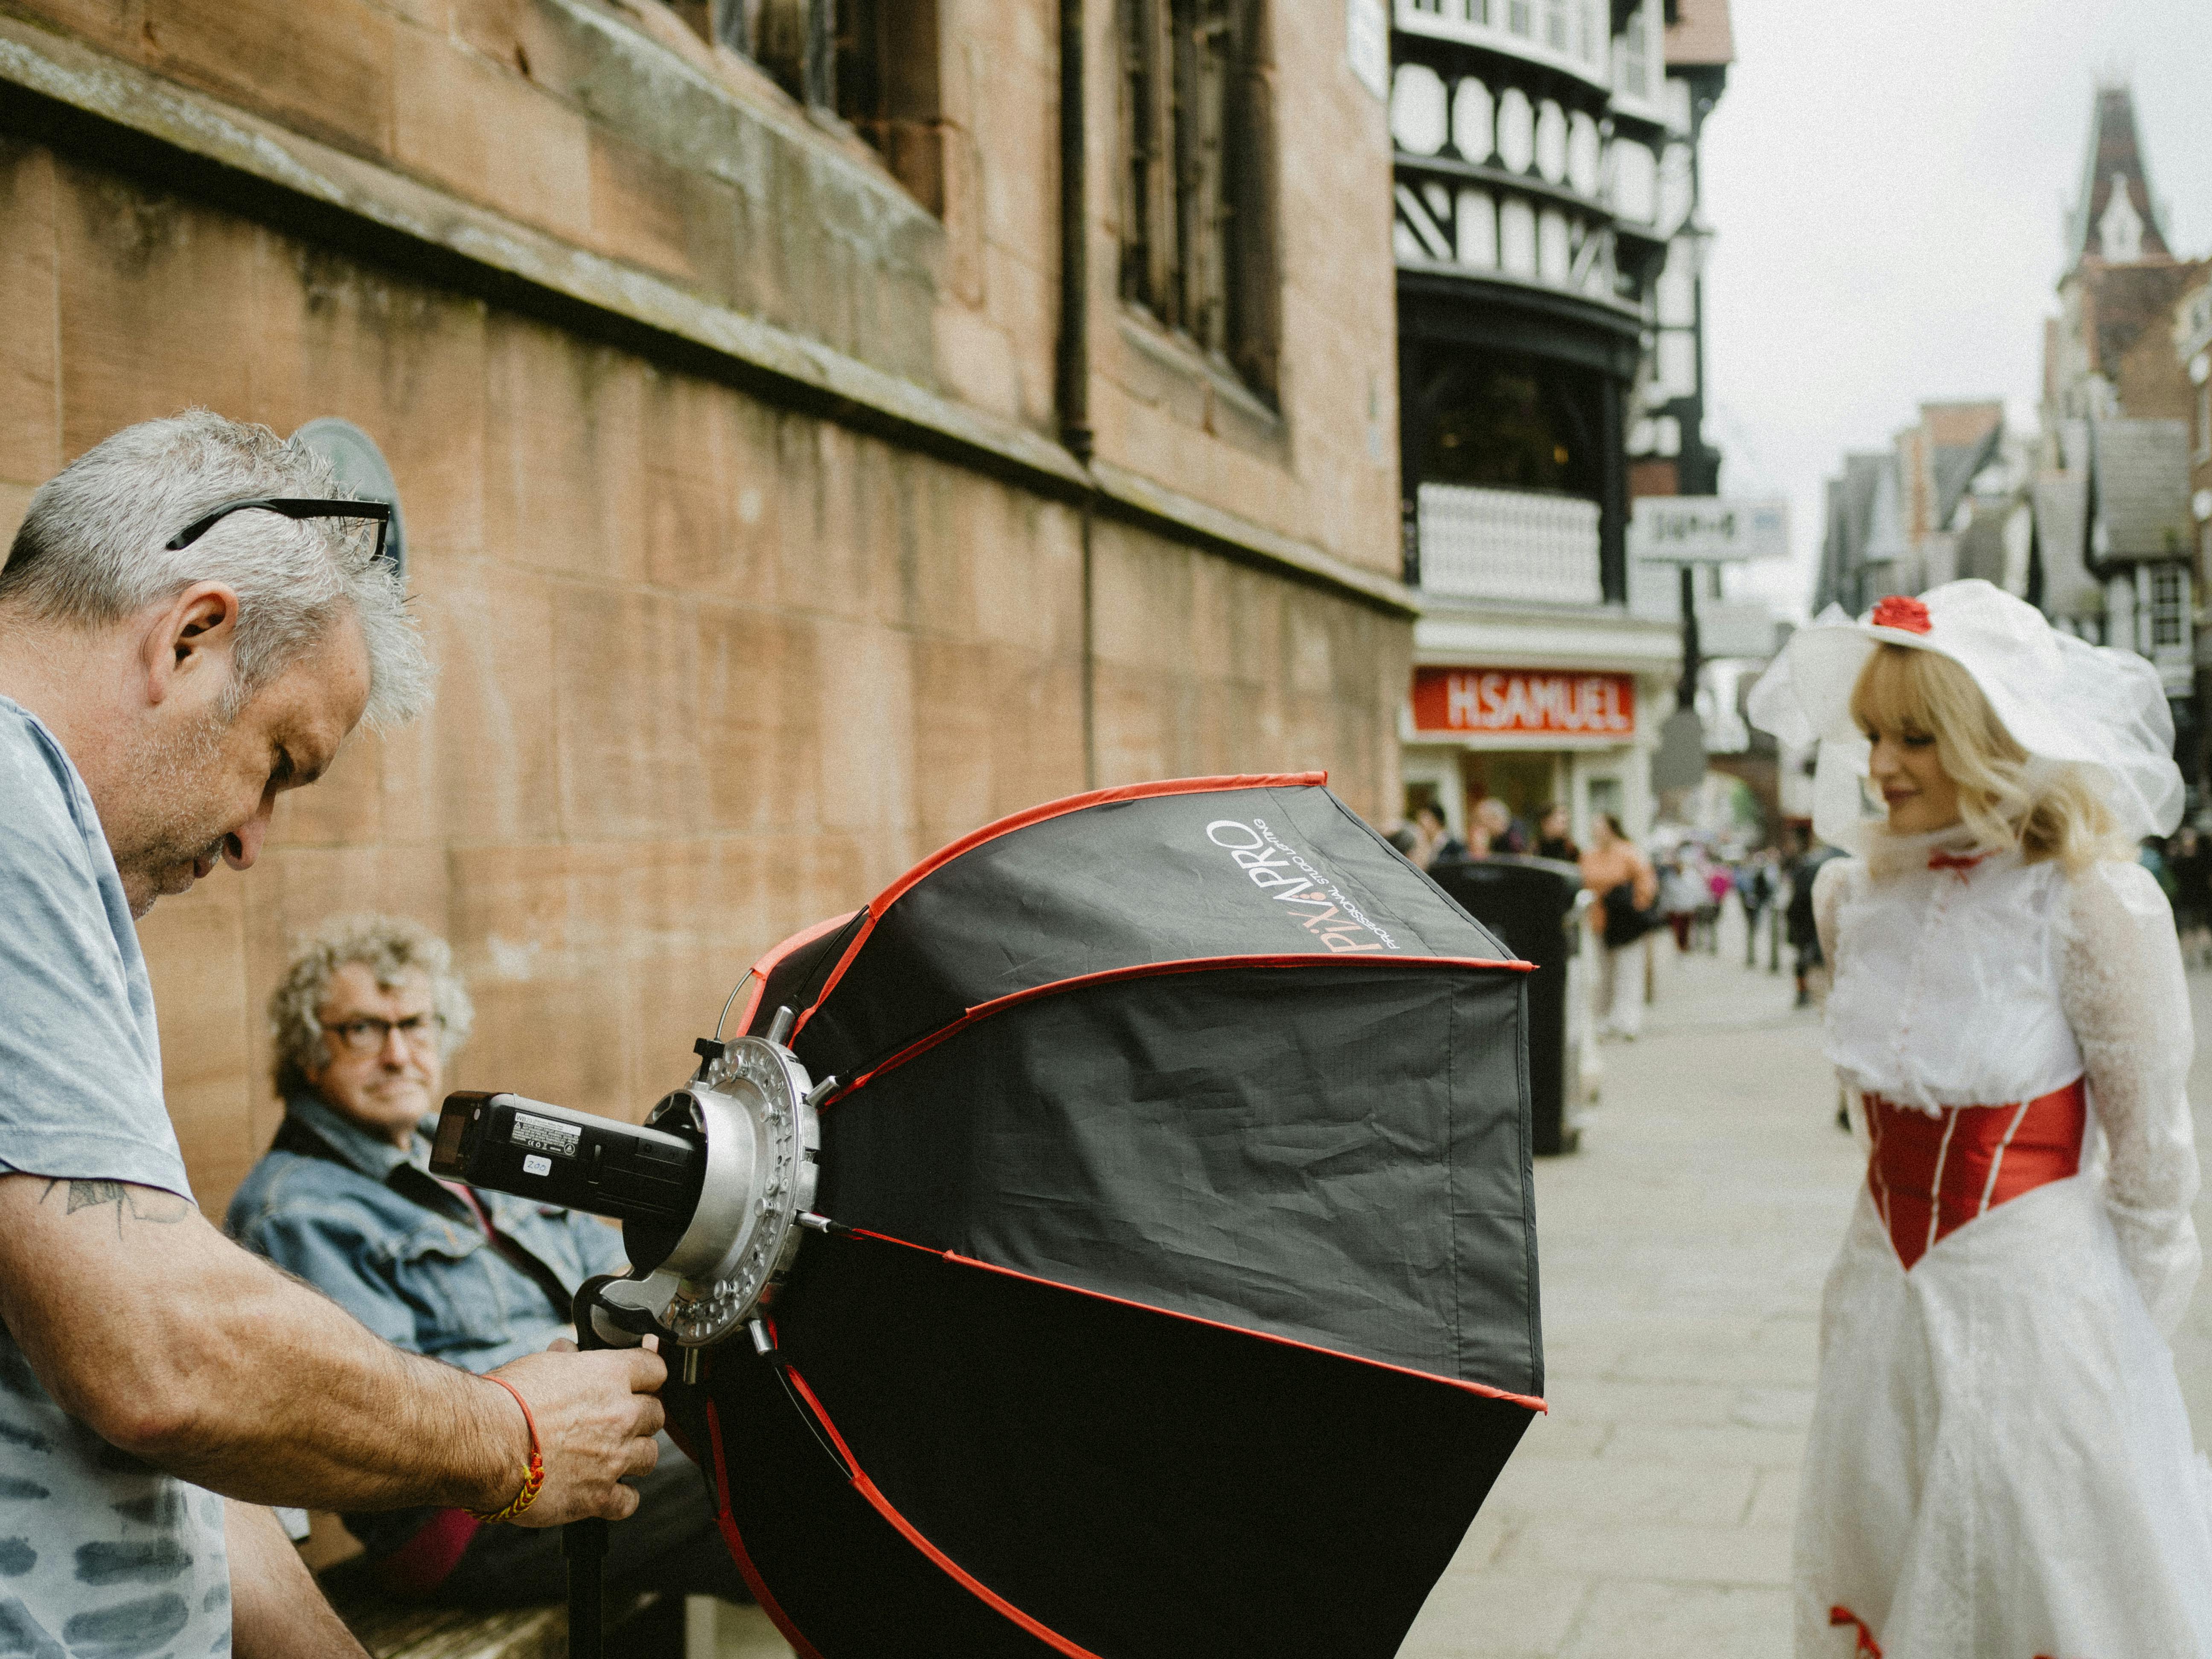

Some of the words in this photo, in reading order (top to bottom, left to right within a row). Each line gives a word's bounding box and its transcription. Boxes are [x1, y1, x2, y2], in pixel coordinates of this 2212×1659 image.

[1254, 818, 1296, 856] LIGHTING
[1292, 856, 1329, 885] STUDIO
[1328, 885, 1400, 950] PROFESSIONAL
[527, 1161, 546, 1171] 200
